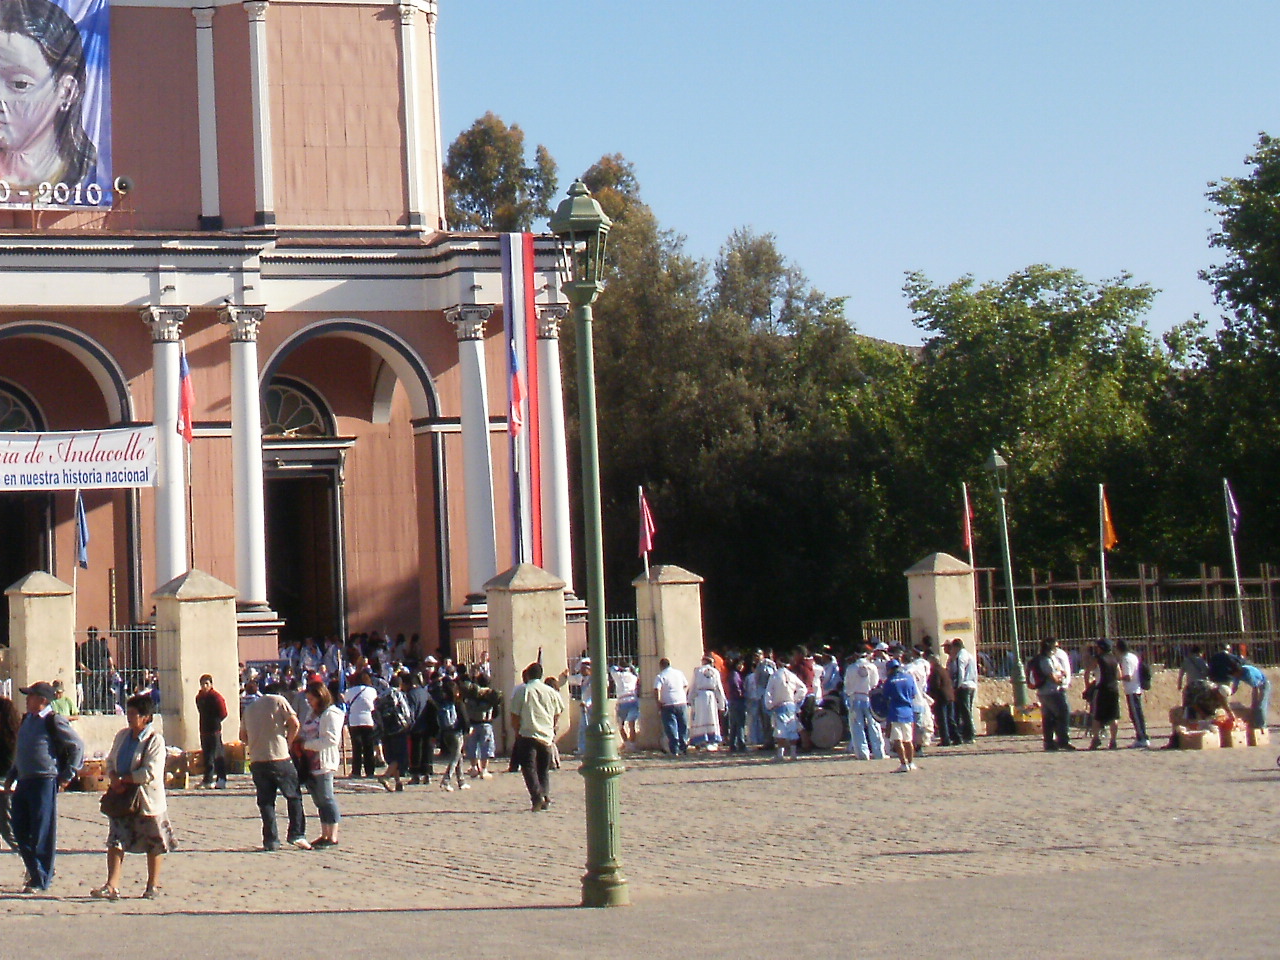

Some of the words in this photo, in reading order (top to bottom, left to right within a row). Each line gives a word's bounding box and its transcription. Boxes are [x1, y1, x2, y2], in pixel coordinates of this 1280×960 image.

[38, 181, 103, 205] 2010
[24, 434, 44, 464] de
[4, 473, 17, 485] en
[20, 470, 60, 485] nuestra
[62, 468, 102, 484] historia
[105, 466, 149, 483] nacional
